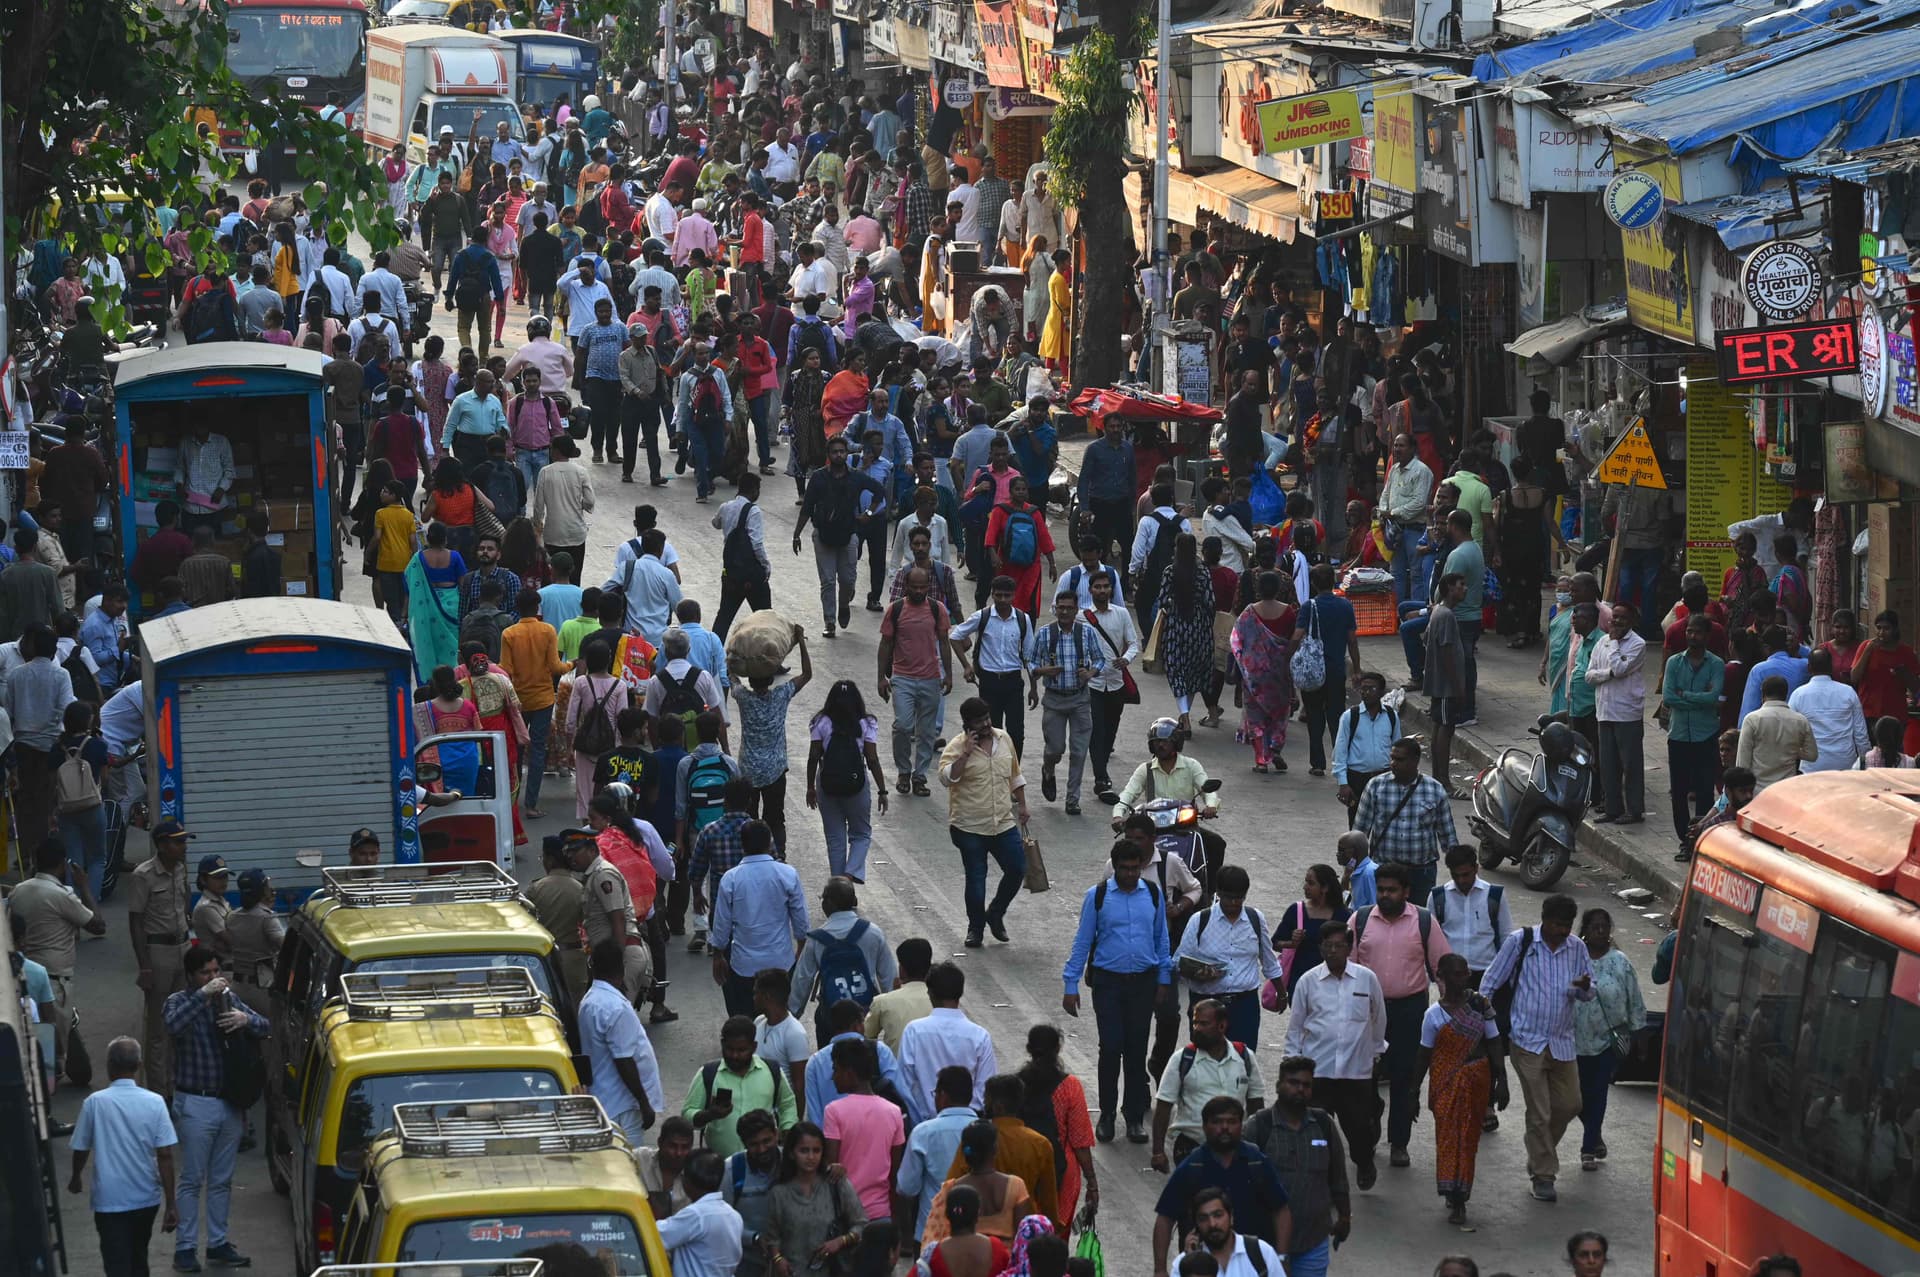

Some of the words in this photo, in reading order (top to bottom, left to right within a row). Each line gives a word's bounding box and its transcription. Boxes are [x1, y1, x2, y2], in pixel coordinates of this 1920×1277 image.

[952, 93, 972, 102] 199
[1287, 101, 1313, 122] JK
[1274, 118, 1351, 142] JUMBOKING
[1540, 132, 1592, 146] RIDDHI
[1321, 192, 1352, 217] 350
[1609, 182, 1623, 222] SADHANA
[1623, 175, 1654, 188] SNACKS
[1626, 208, 1646, 226] SINCE
[1750, 244, 1784, 272] INDIA'S
[1786, 244, 1815, 264] FIRST
[1759, 270, 1792, 281] HEALTHY
[1759, 274, 1808, 298] गुळाचा
[1747, 282, 1785, 319] ORIGINAL
[1787, 310, 1795, 319] &
[1796, 272, 1821, 315] TRUSTED
[1775, 289, 1797, 301] चहा
[1723, 333, 1798, 375] ER
[1811, 323, 1855, 365] श्री
[1616, 453, 1632, 464] नाही
[1636, 456, 1653, 467] पाणी
[1611, 467, 1627, 478] नाही
[1631, 469, 1653, 480] जीवन
[1692, 860, 1718, 893] ZERO
[1715, 872, 1758, 912] EMISSION
